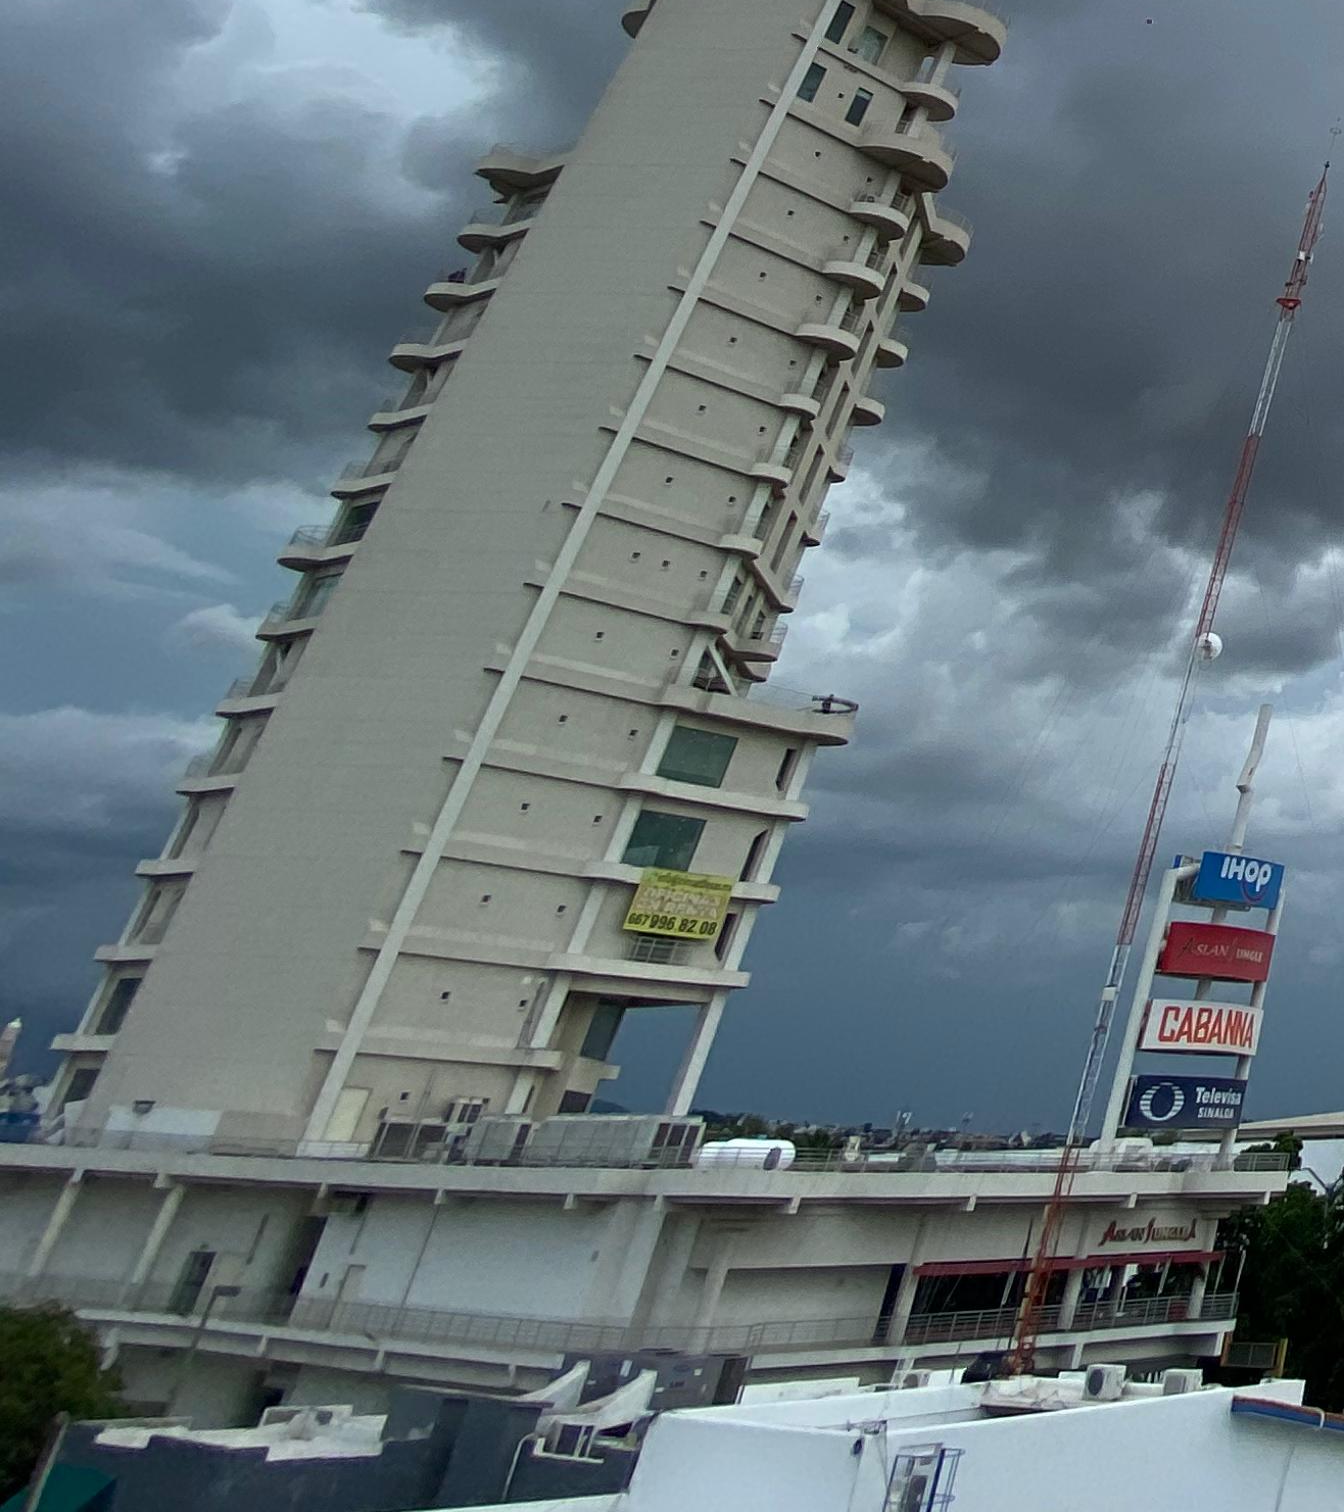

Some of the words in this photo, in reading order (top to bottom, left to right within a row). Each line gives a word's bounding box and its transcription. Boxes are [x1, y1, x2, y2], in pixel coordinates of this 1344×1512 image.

[1221, 856, 1272, 892] IHOP
[1158, 1005, 1254, 1048] CABANNA
[1195, 1086, 1242, 1105] Televisa
[1197, 1107, 1235, 1119] SINALOA
